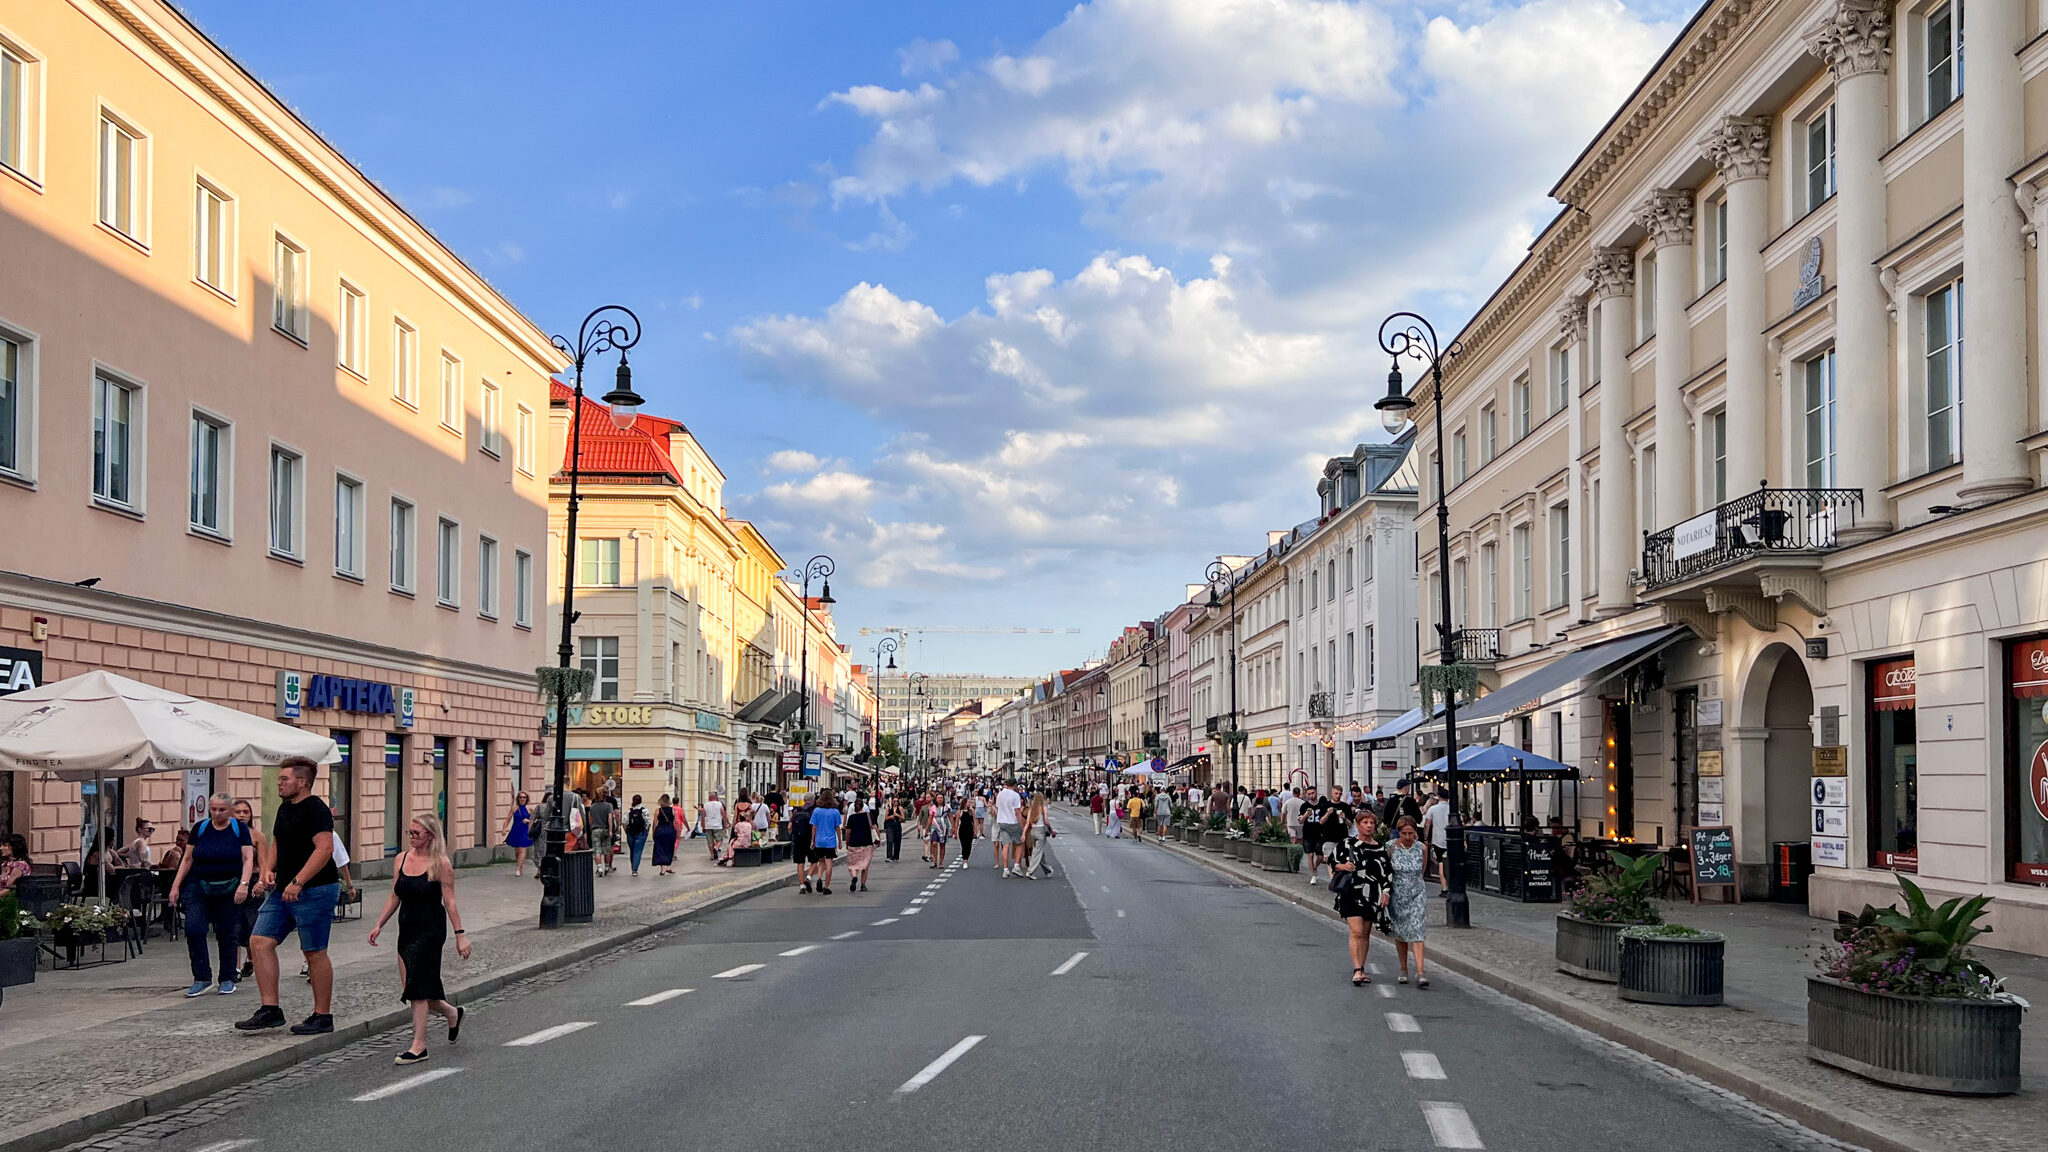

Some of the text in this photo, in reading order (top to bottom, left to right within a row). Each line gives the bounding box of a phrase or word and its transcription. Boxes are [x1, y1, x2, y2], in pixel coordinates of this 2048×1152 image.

[1676, 525, 1713, 546] NOTARIUSZ
[308, 674, 395, 714] APTEKA
[590, 706, 652, 725] STORE
[156, 756, 195, 766] FIND TEA
